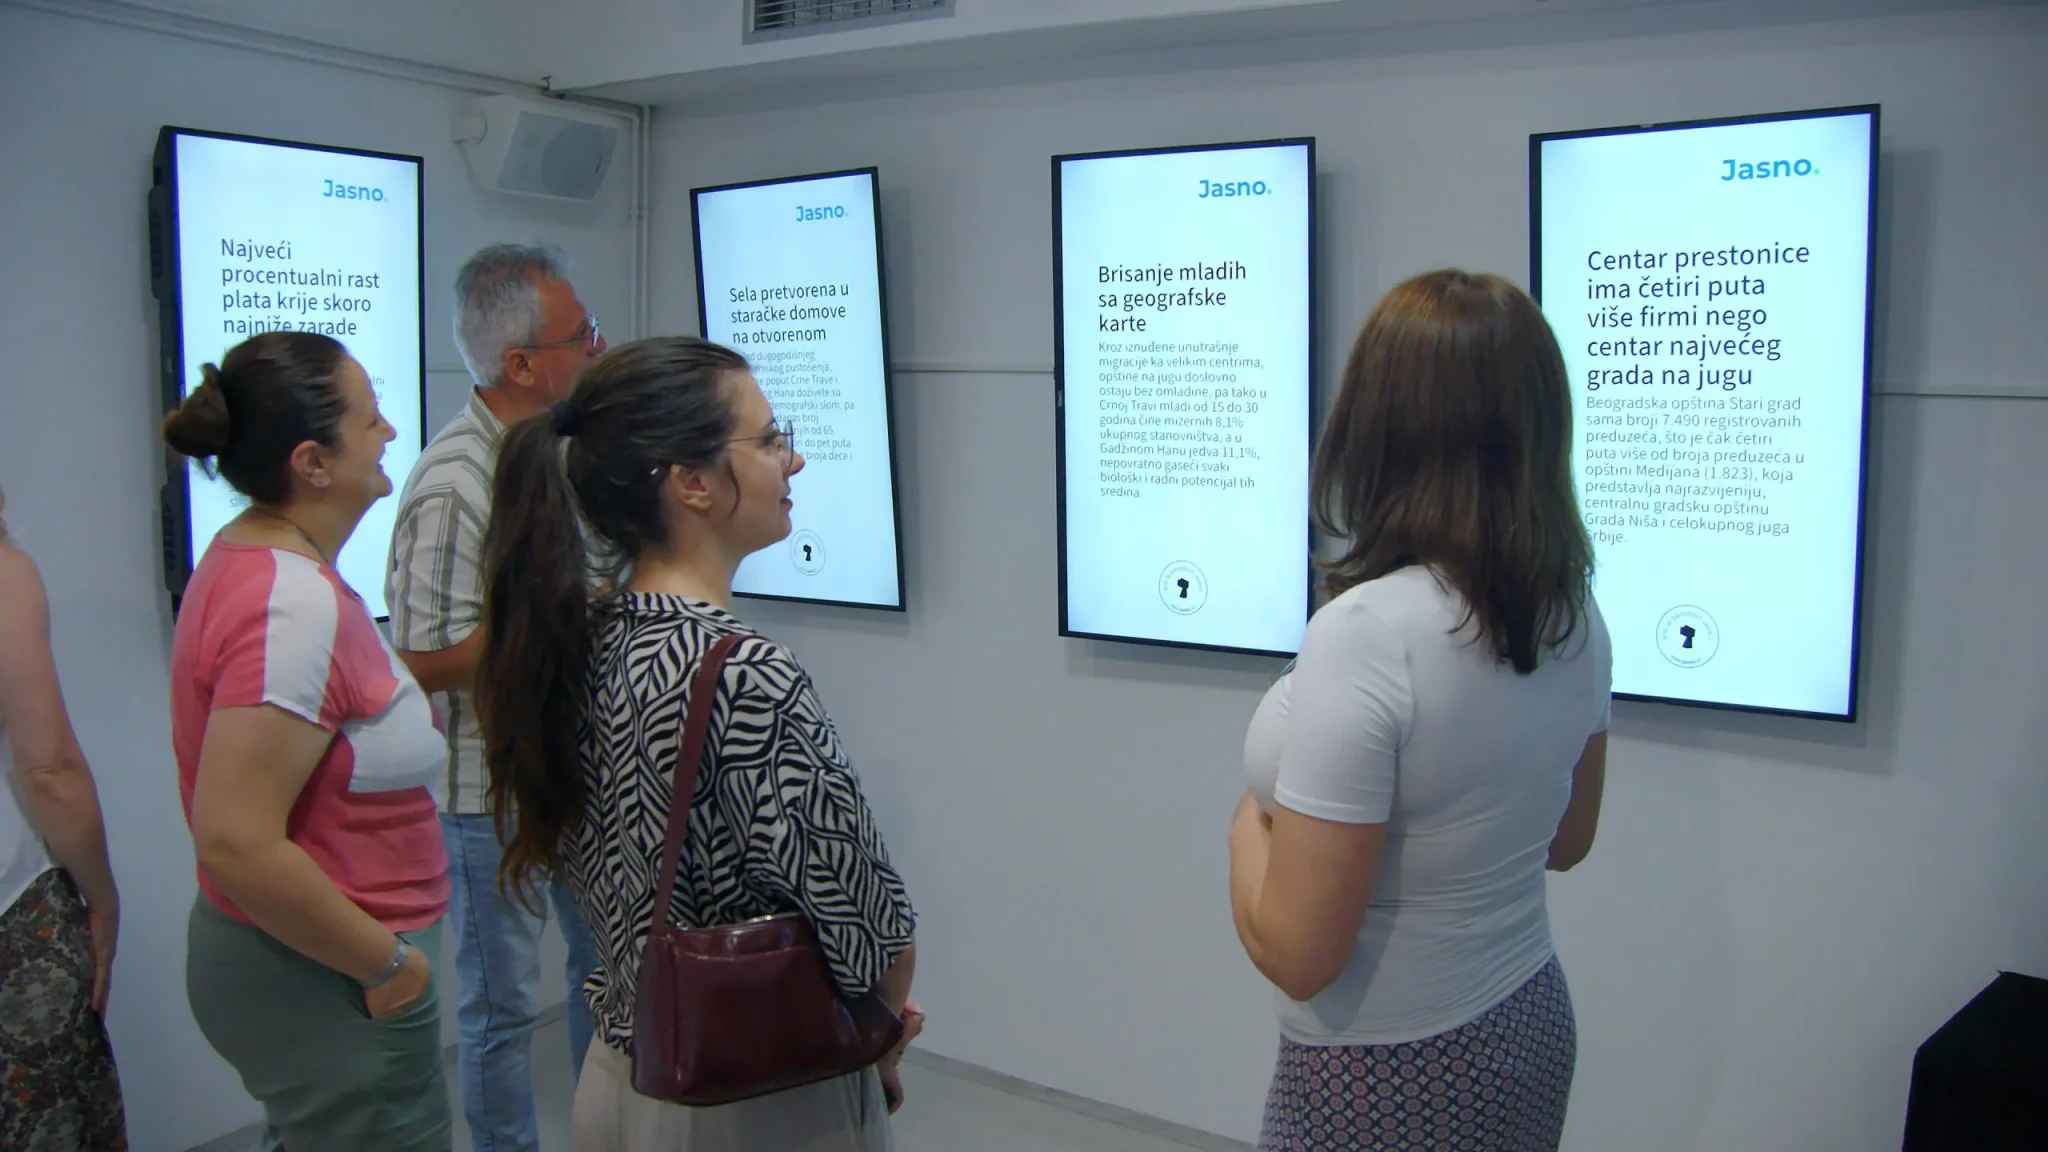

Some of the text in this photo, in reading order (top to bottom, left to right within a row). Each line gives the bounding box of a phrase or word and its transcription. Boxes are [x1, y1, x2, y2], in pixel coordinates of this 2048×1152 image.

[1721, 158, 1819, 181] Jasno.
[1198, 179, 1272, 199] Jasno.
[221, 238, 292, 262] Najveći
[1588, 241, 1809, 273] Centar prestonice
[222, 267, 380, 289] procentualni rast
[1099, 260, 1246, 287] Brisanje mladih
[729, 284, 849, 304] Sela pretvorena u
[1588, 275, 1765, 302] ima četiri puta
[222, 289, 372, 315] plata krije skoro
[1098, 287, 1226, 312] sa geografske
[731, 304, 846, 324] staračke domove
[1099, 313, 1146, 332] karte
[1587, 304, 1767, 331] više firmi nego
[223, 315, 357, 337] najniže zarade
[732, 328, 826, 344] na otvorenom
[1098, 340, 1239, 356] Kroz iznuđene unutrašnje
[1587, 332, 1781, 361] centar najvećeg
[1098, 358, 1149, 370] migracije
[1150, 355, 1164, 367] ka
[1166, 355, 1207, 368] velikim
[1098, 369, 1237, 385] opštine na jugu doslovno
[1587, 363, 1752, 391] grada na jugu
[1099, 385, 1132, 399] ostaju
[1134, 385, 1153, 397] bez
[1214, 388, 1229, 400] pa
[1231, 385, 1257, 399] tako
[1259, 390, 1267, 399] u
[1099, 399, 1259, 414] Crnoj Travi mladi od 15 do 30
[1586, 396, 1801, 414] Beogradska opština Stari grad
[1099, 413, 1244, 429] godina čine mizernih 8,1%
[1586, 413, 1801, 431] sama broji 7.490 registrovanih
[1100, 427, 1147, 443] ukupnog
[1225, 433, 1232, 443] a
[1234, 435, 1242, 443] u
[1586, 429, 1772, 448] preduzeća, što je čak četiri
[1099, 441, 1154, 455] Gadžinom
[1156, 444, 1186, 456] Hanu
[1188, 445, 1219, 459] jedva
[1585, 446, 1804, 465] puta više od broja preduzeća u
[1100, 458, 1230, 473] nepovratno gaseći svaki
[1585, 462, 1793, 484] opštini Medijana (1.823), koja
[1100, 471, 1255, 490] biološki i radni potencijal tih
[1585, 479, 1766, 501] predstavlja najrazvijeniju,
[1584, 497, 1769, 516] centralnu gradsku opštinu
[1584, 512, 1790, 537] Grada Niša i celokupnog juga
